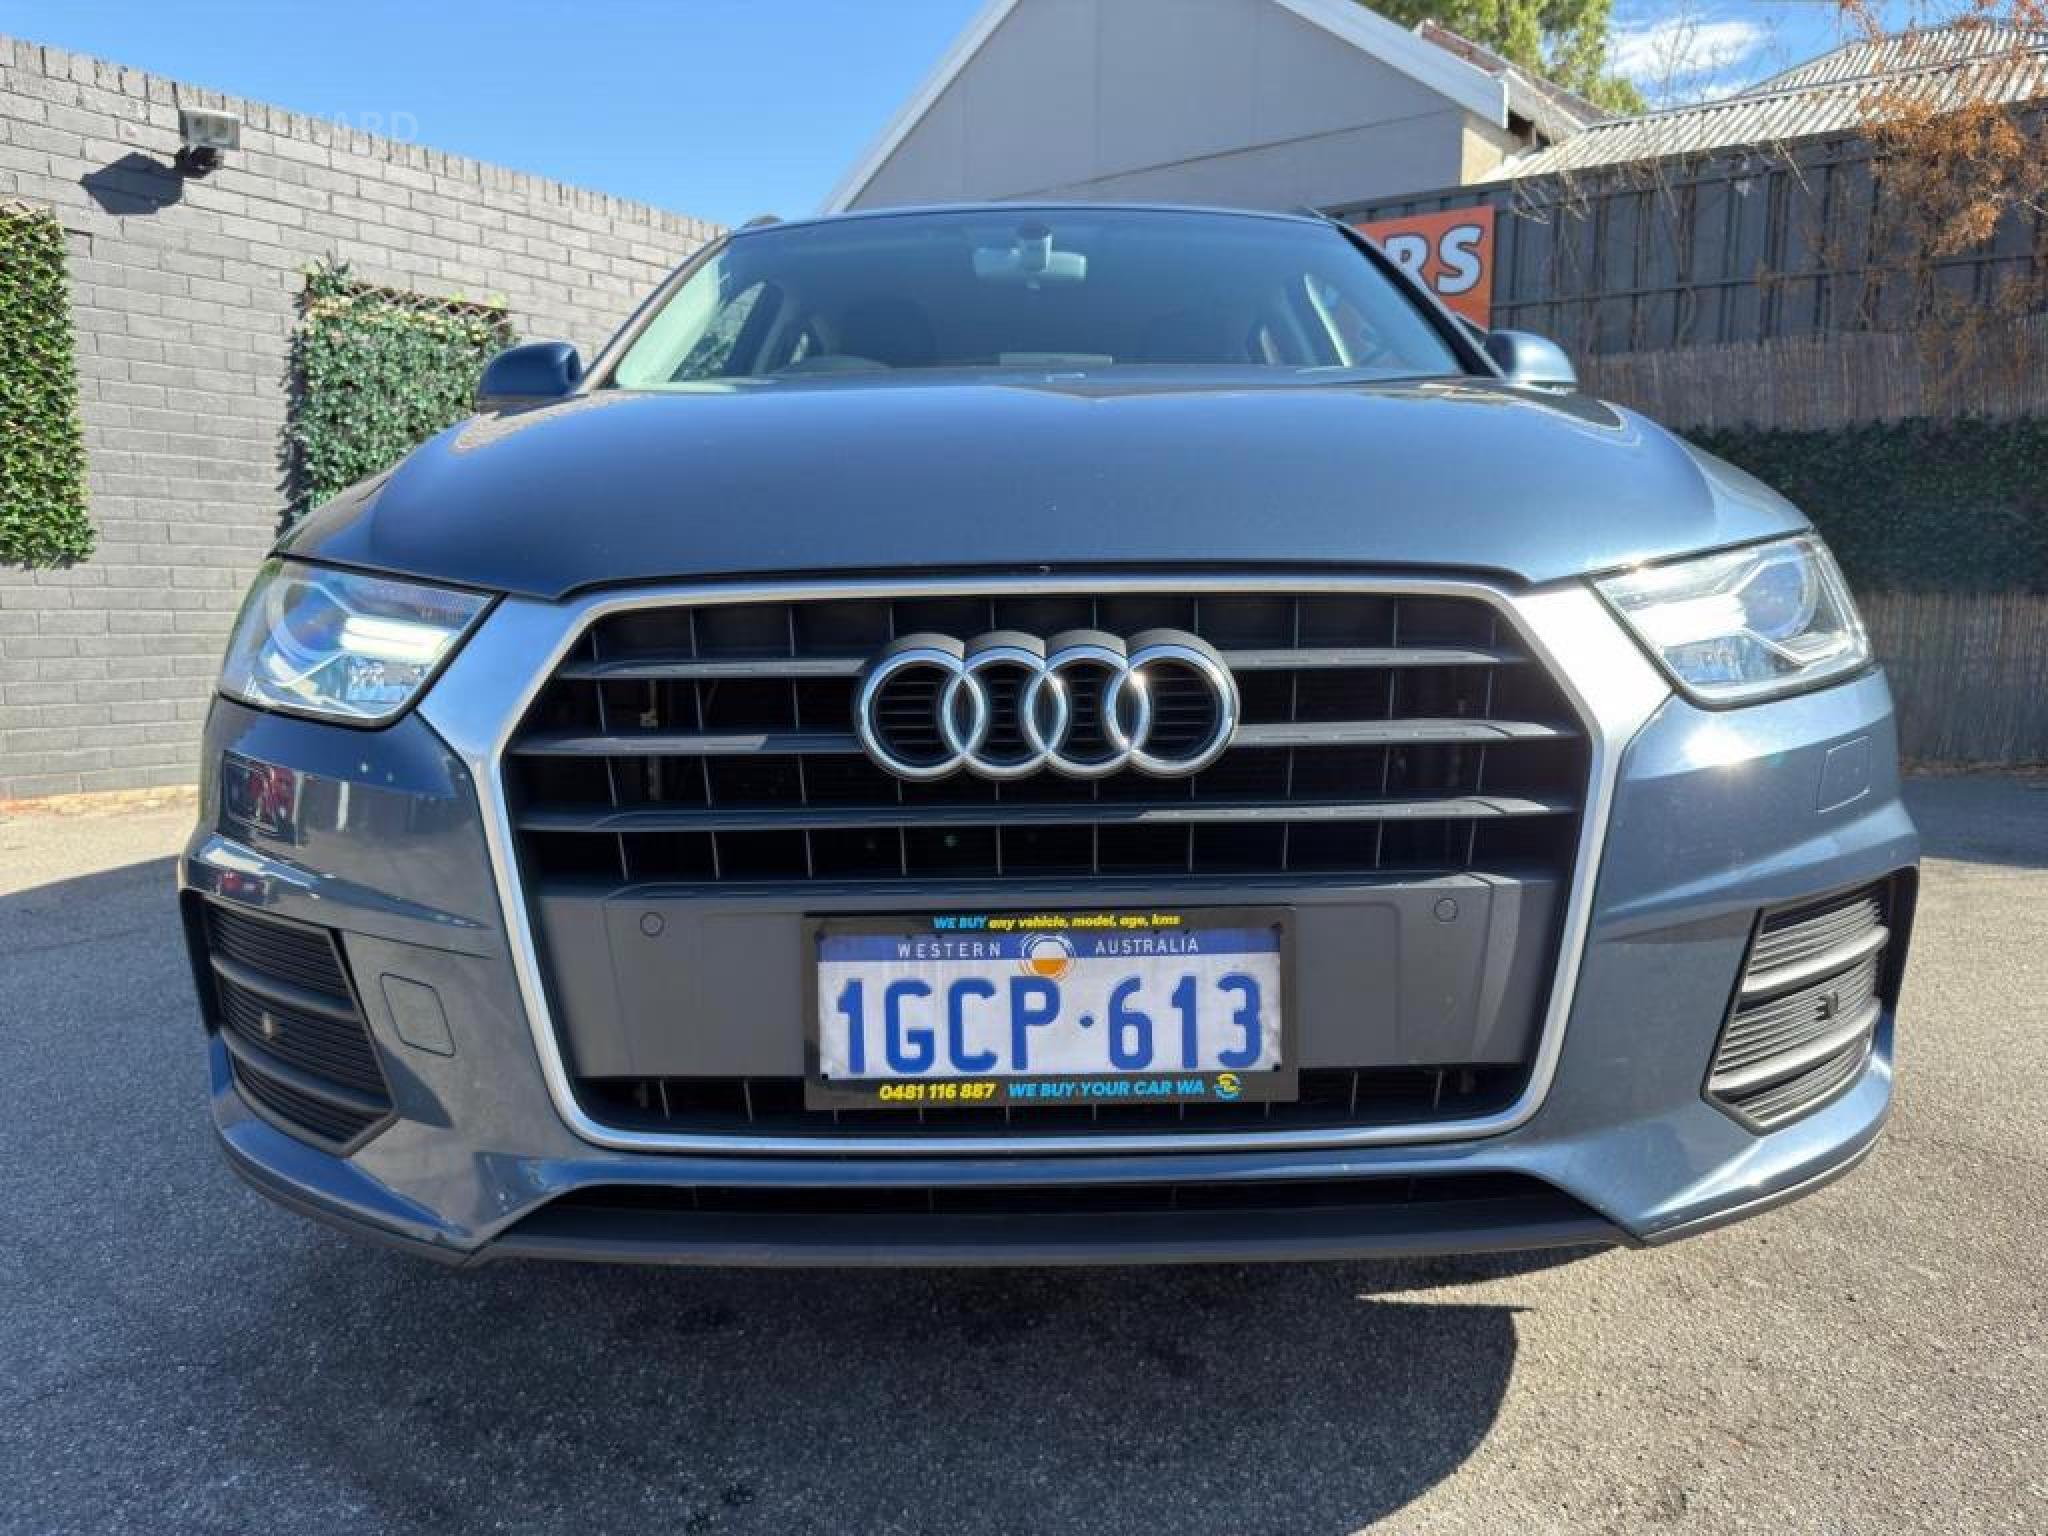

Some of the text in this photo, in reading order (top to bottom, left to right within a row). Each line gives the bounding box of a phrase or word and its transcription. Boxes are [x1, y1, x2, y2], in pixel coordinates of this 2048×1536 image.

[934, 916, 957, 929] WE
[959, 915, 988, 929] BUY
[989, 919, 1016, 931] any
[897, 943, 1001, 959] WESTERN
[1094, 937, 1200, 955] AUSTRALIA
[879, 1082, 997, 1100] 0481 116 887
[1008, 1079, 1205, 1097] WE BUY YOUR CAR WA
